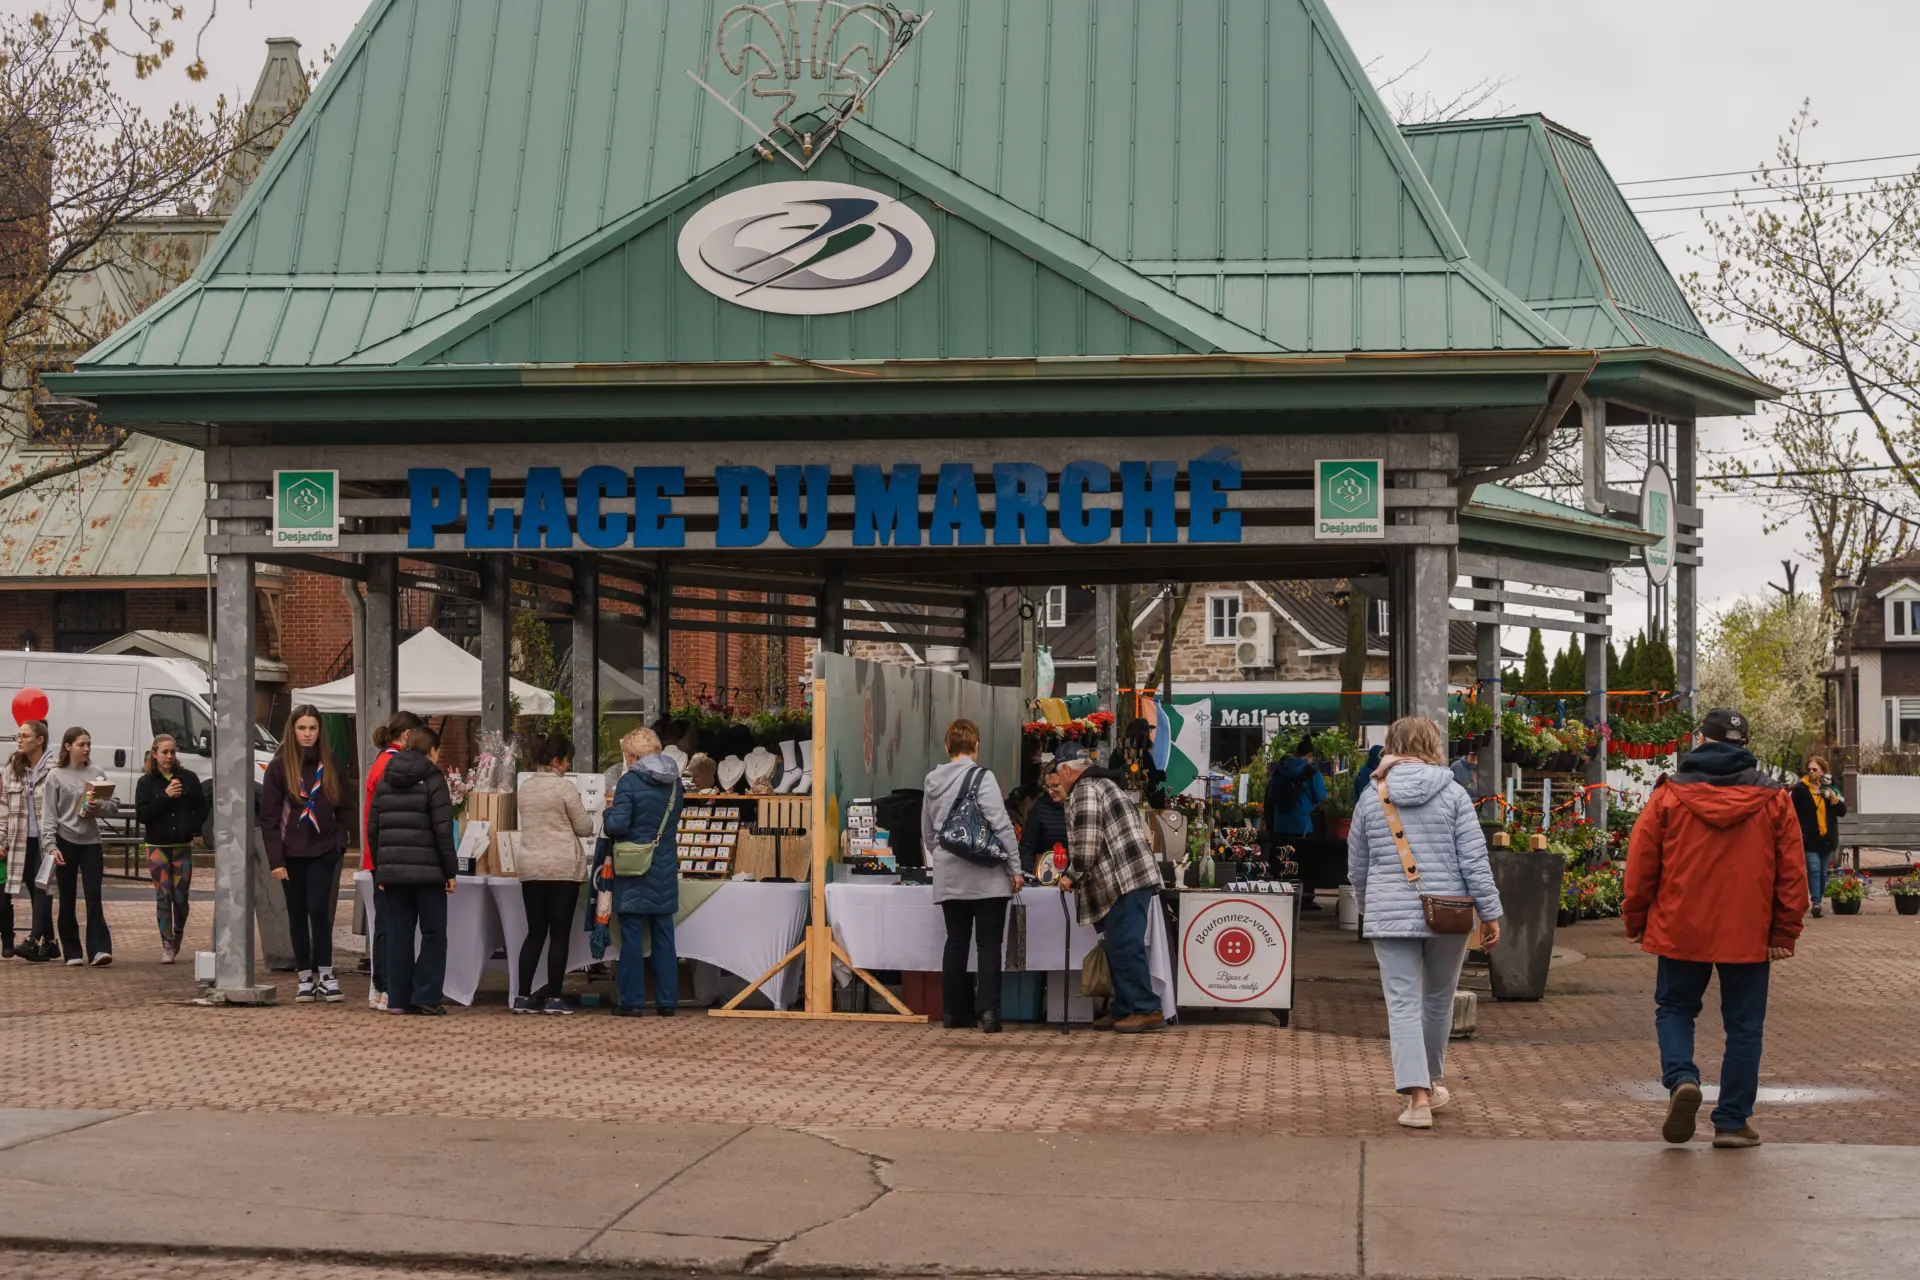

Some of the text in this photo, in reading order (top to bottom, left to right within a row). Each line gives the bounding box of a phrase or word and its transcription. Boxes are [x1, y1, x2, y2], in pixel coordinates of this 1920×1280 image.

[407, 446, 1242, 549] PLACE DU MARCHÉ
[278, 531, 333, 544] Desjardins
[1320, 522, 1378, 536] Desjardins
[1220, 708, 1310, 726] Malltte
[1195, 914, 1277, 947] Boutonnez-vous!
